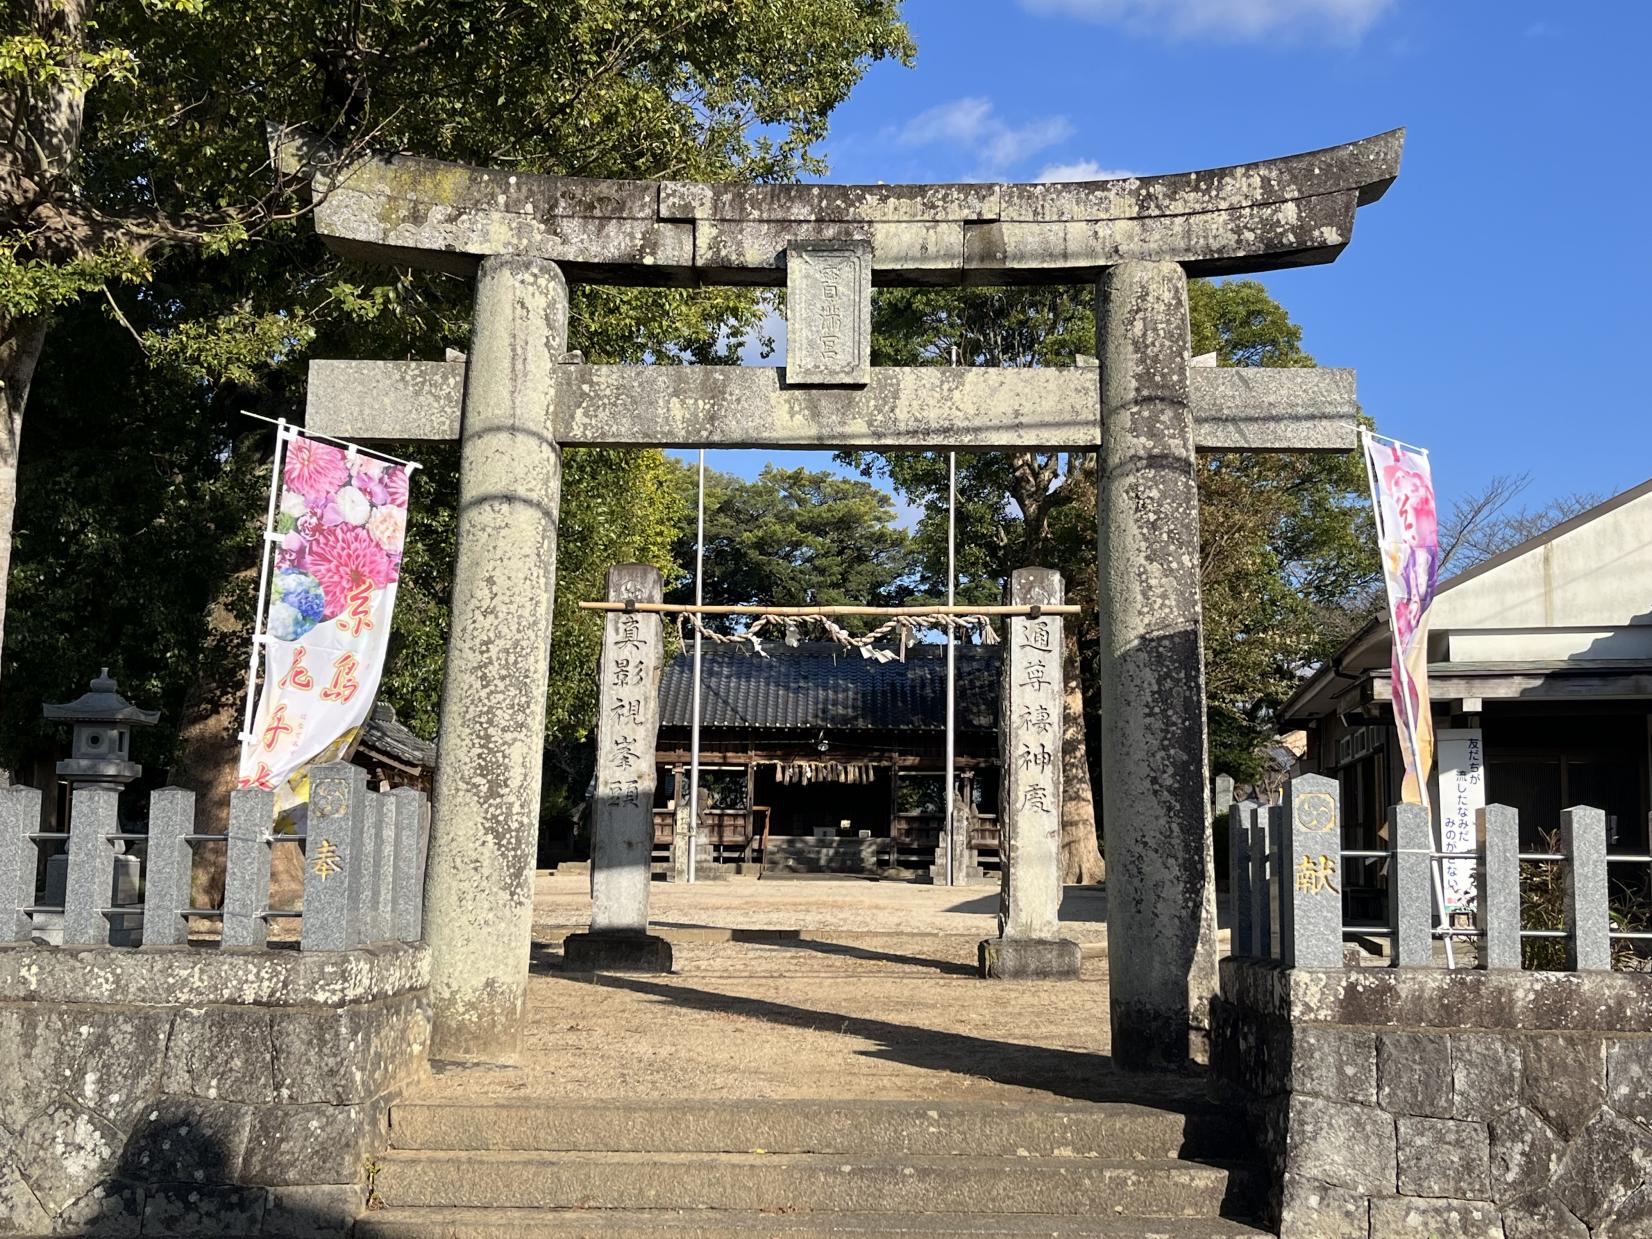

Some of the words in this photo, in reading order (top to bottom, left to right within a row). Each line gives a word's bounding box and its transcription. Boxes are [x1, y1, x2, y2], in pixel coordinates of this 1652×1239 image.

[321, 578, 374, 704] 糸島
[1468, 738, 1480, 785] 友だちが
[1456, 770, 1469, 842] 流したなみだ
[311, 838, 344, 882] 奉
[1296, 854, 1340, 896] 献
